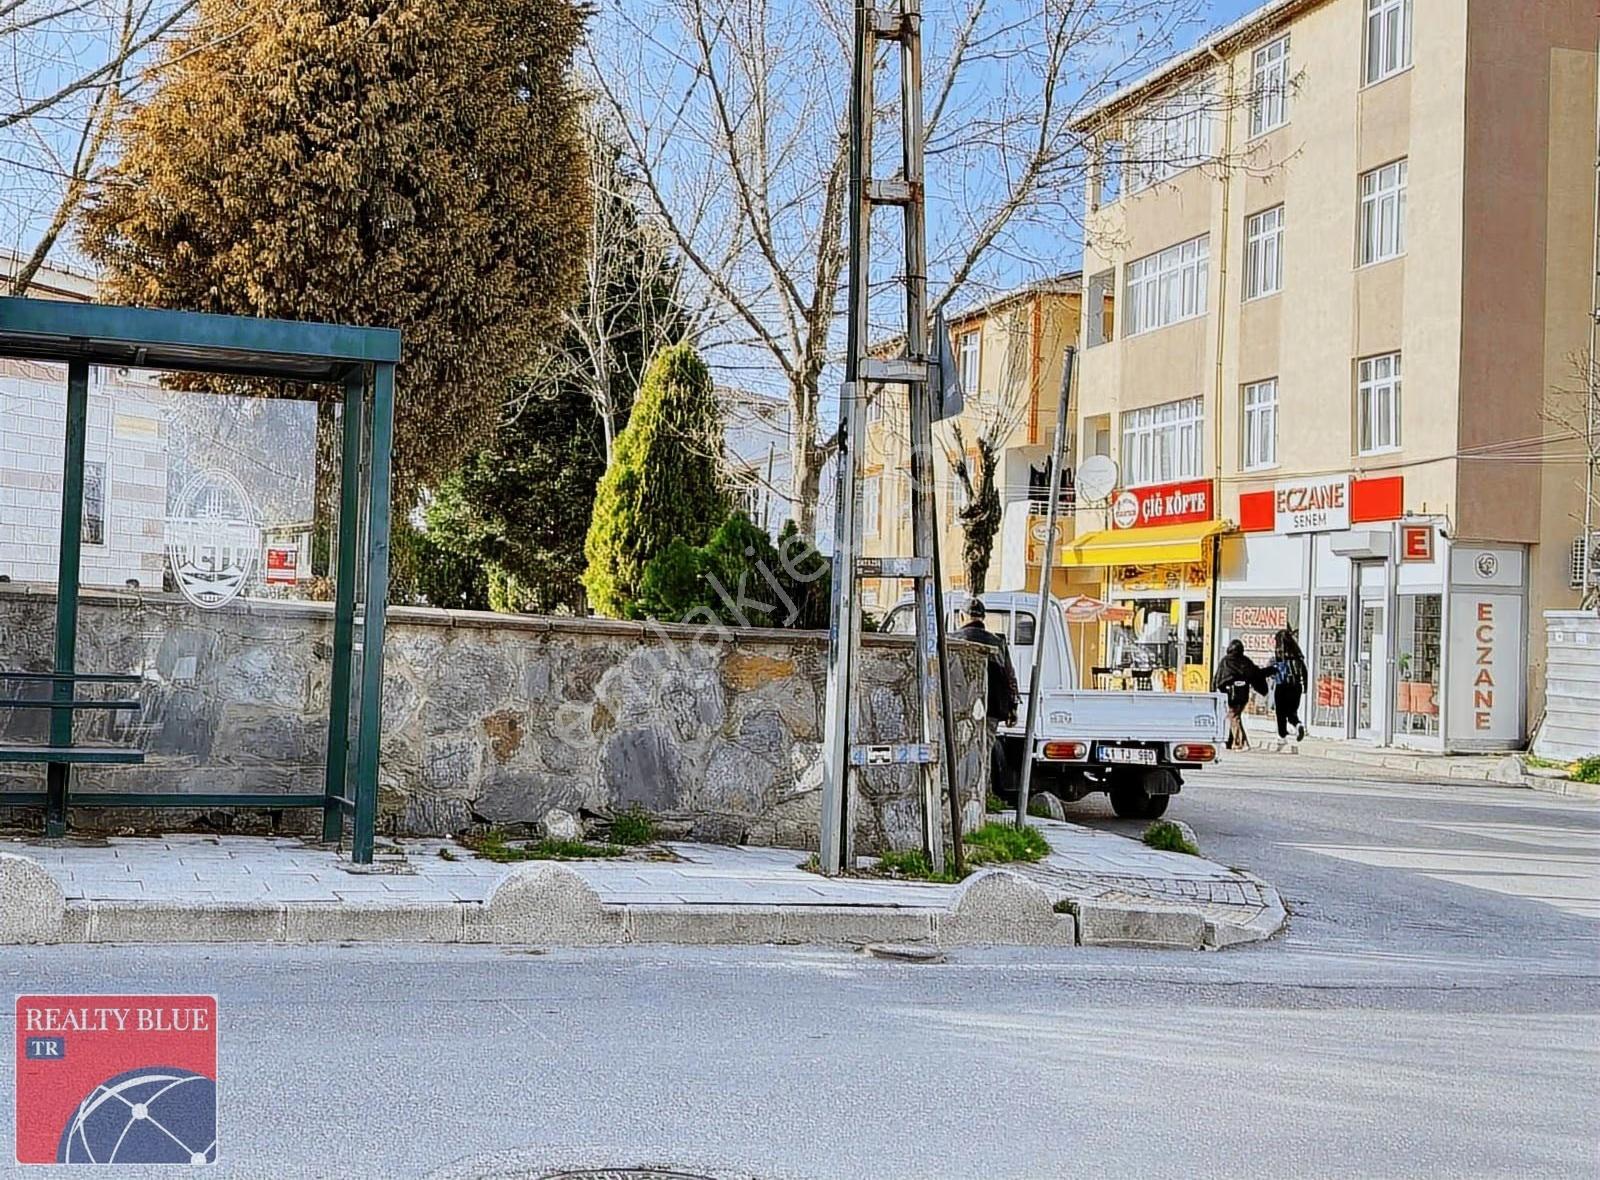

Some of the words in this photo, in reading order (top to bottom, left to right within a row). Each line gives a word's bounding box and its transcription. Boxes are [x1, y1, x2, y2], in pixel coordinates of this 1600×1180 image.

[1142, 492, 1163, 524] ÇİĞ
[1277, 483, 1344, 513] ECZANE
[1294, 512, 1327, 528] SENEM
[1407, 530, 1427, 555] E
[1233, 607, 1287, 628] ECZANE
[1474, 602, 1494, 730] ECZANE
